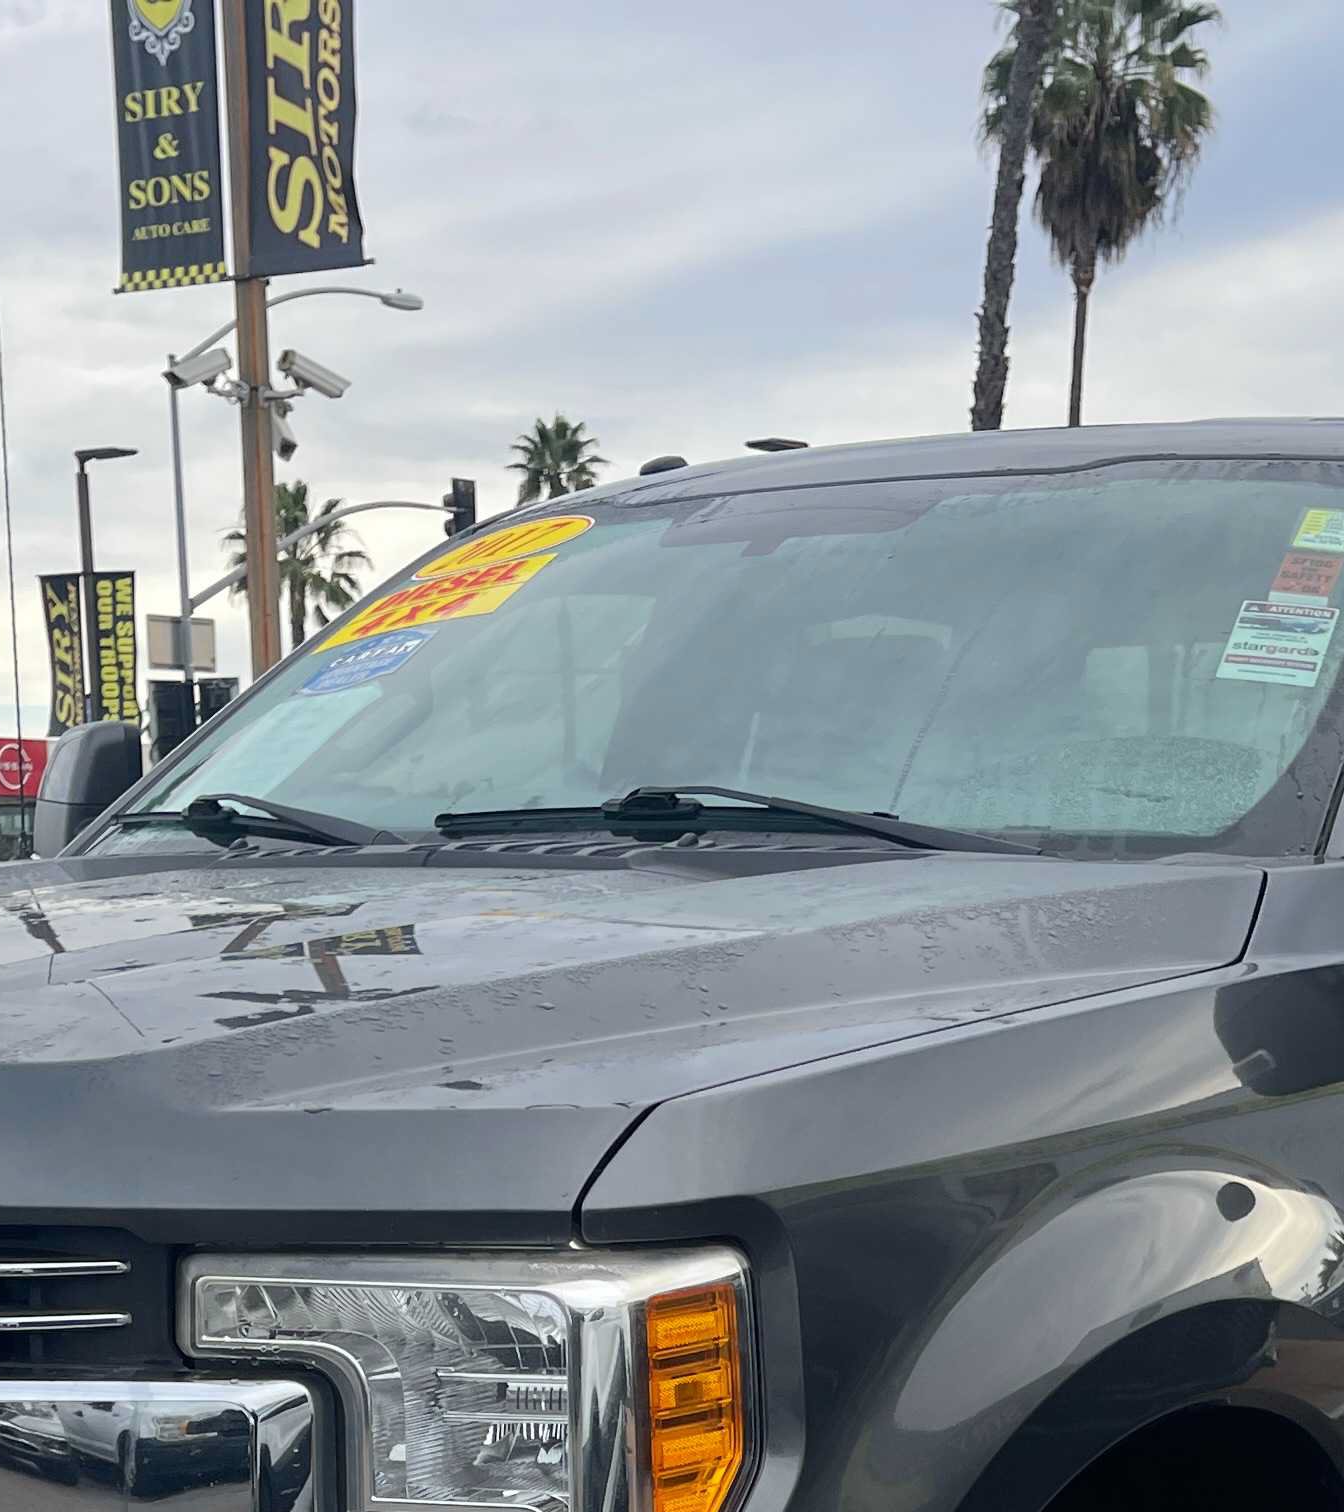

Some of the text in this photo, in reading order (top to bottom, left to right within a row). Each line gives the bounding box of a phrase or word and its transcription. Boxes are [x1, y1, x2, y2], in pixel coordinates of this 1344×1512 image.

[125, 81, 205, 123] SIRY
[153, 132, 179, 160] &
[128, 170, 211, 209] SONS
[132, 218, 211, 240] AUTO CARE
[96, 579, 113, 630] OUR
[115, 577, 132, 616] WE
[370, 559, 530, 614] DIESEL
[45, 582, 75, 728] SIRY
